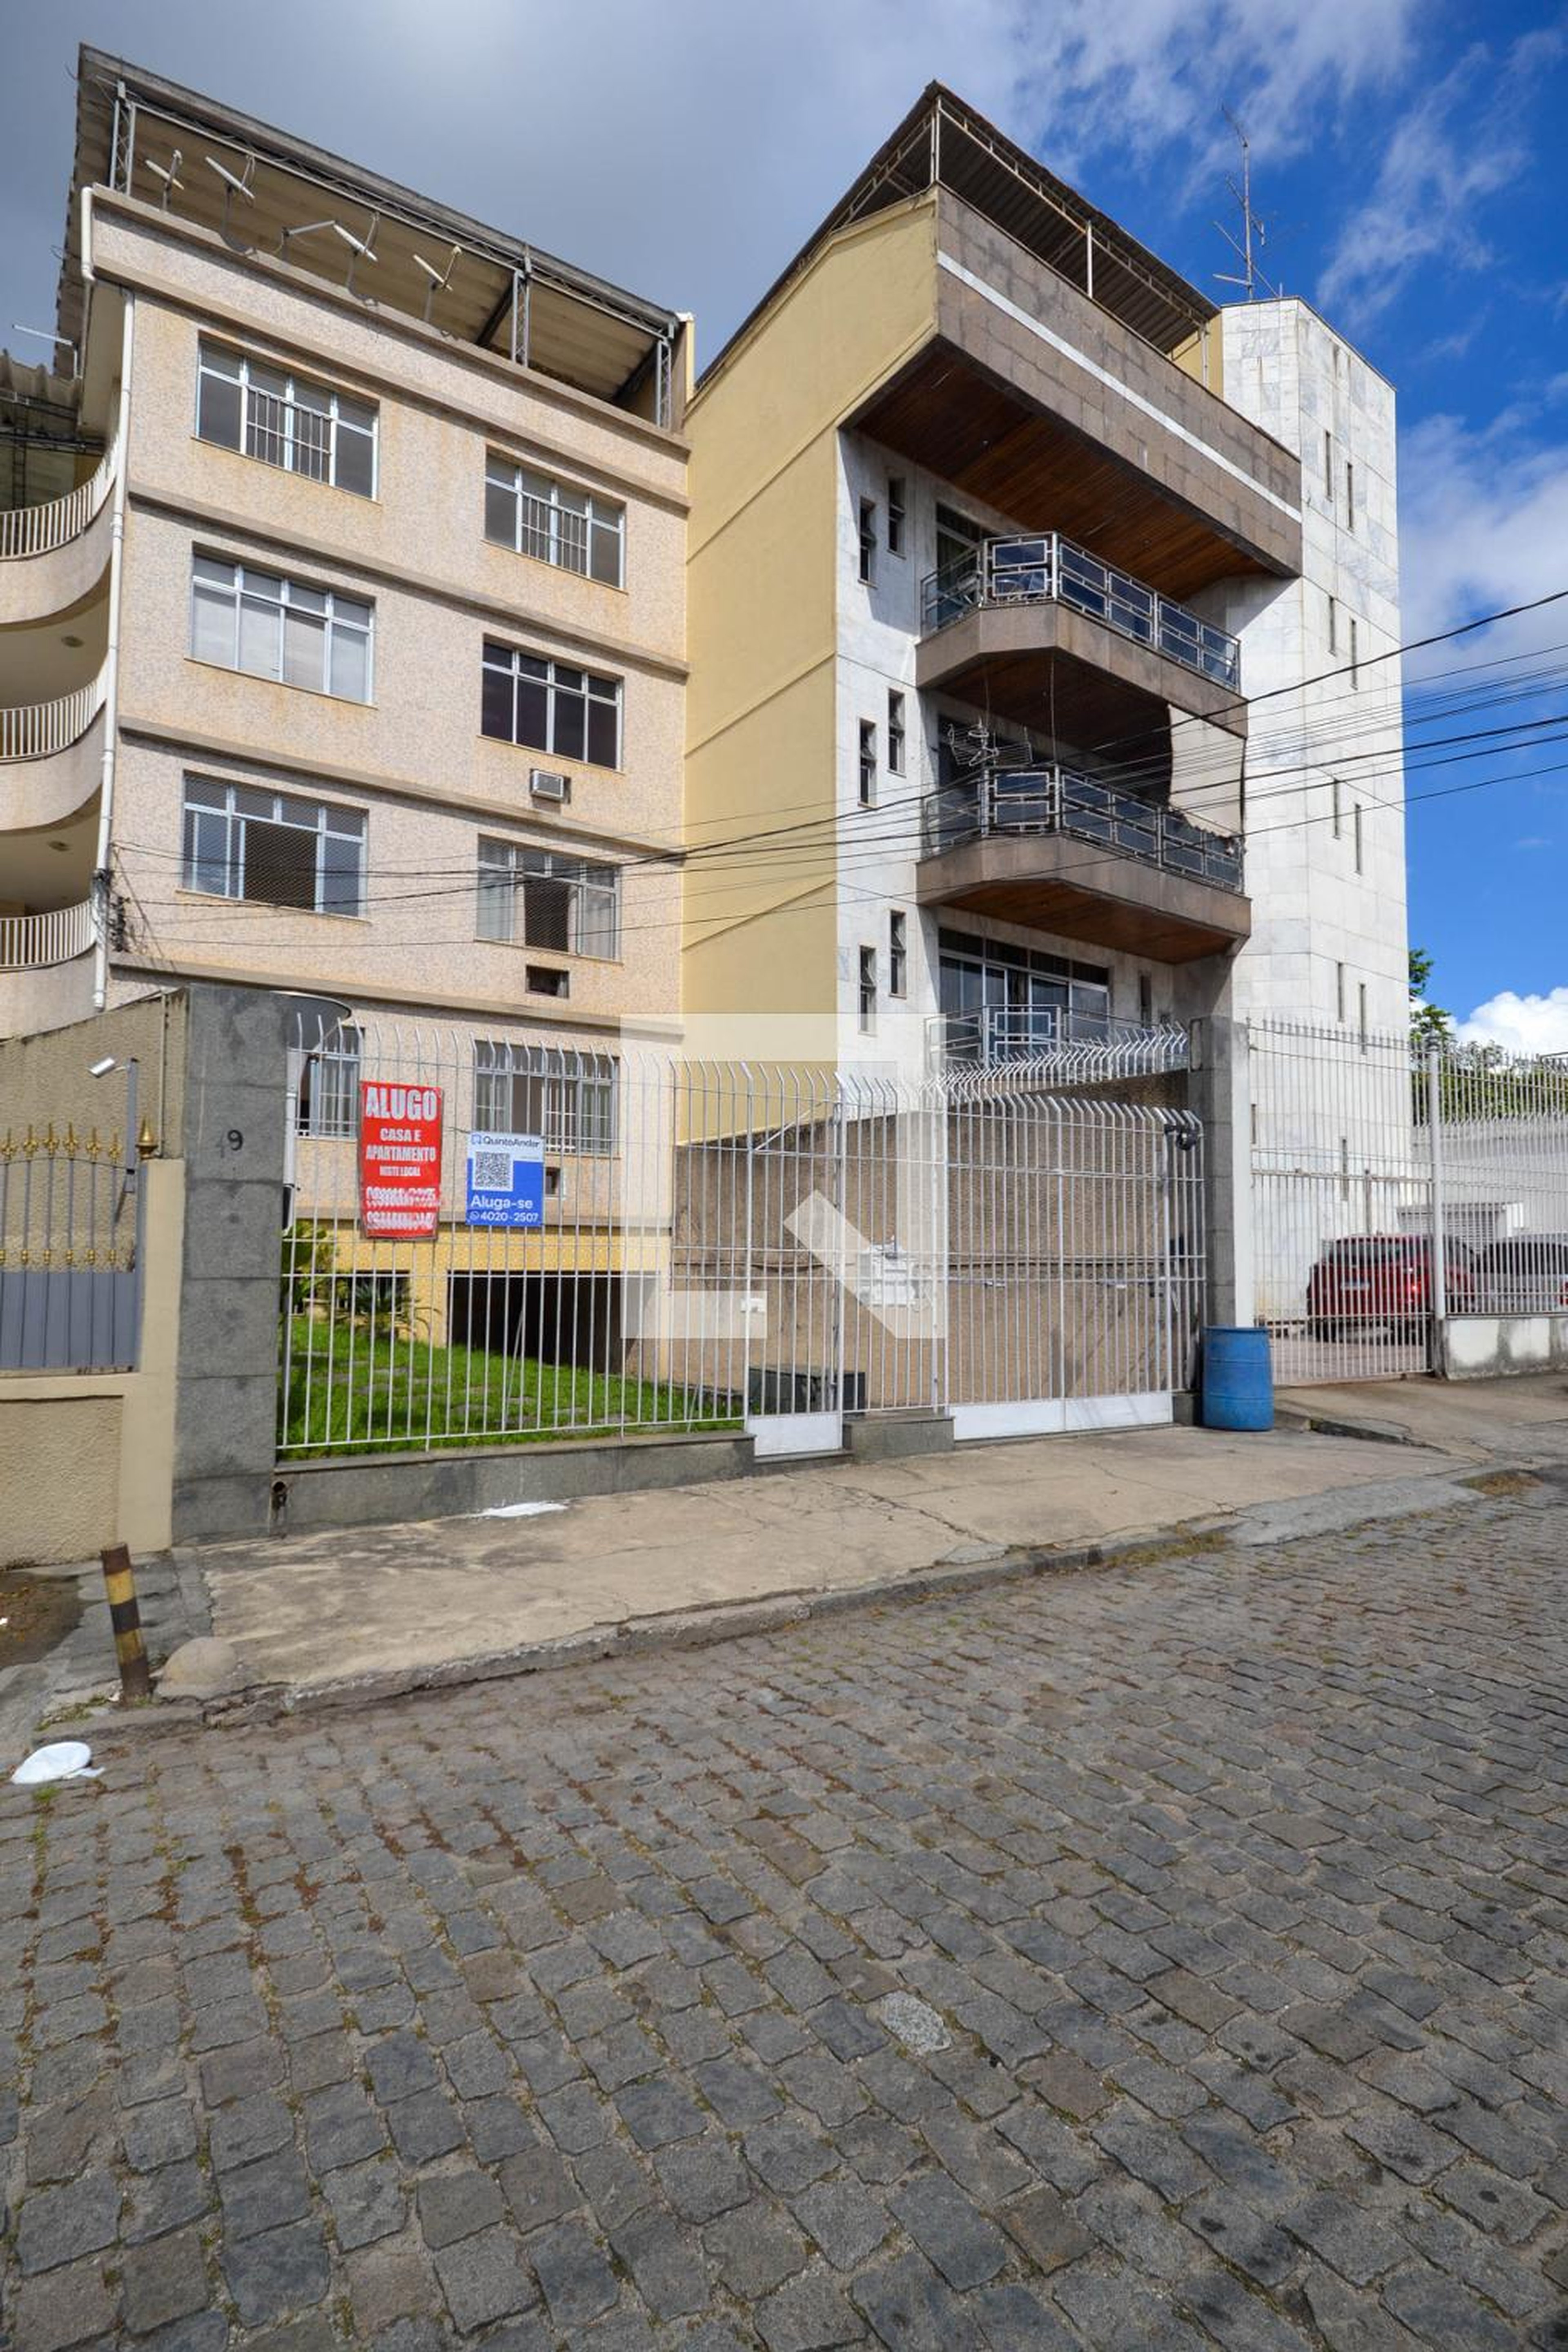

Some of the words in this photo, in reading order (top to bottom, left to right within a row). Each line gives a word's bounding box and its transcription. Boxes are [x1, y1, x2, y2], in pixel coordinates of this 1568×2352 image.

[366, 1087, 437, 1121] ALUGO
[380, 1128, 411, 1142] CASA
[414, 1129, 421, 1142] E
[365, 1145, 436, 1162] APARTAMENTO
[471, 1195, 533, 1211] Aluga-se
